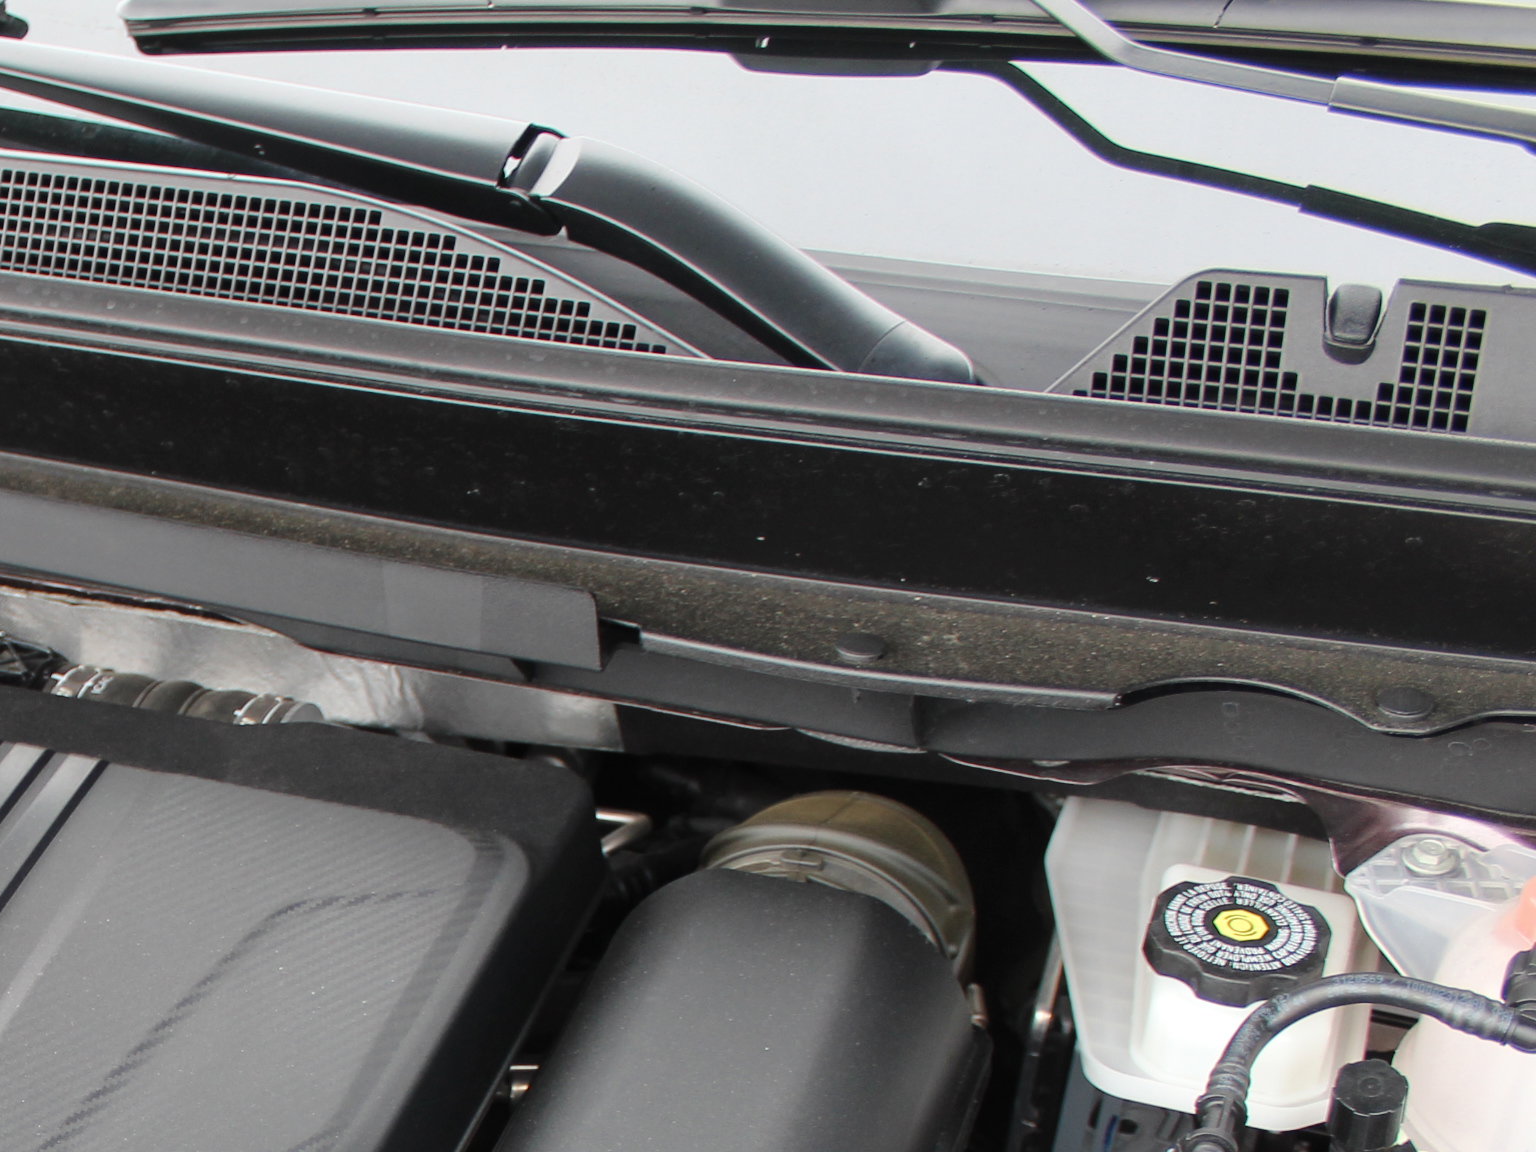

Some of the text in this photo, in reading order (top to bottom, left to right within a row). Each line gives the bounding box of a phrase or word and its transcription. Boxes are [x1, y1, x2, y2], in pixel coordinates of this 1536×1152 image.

[1235, 885, 1285, 903] CONTAINER.
[1280, 901, 1309, 921] SEALED
[1183, 944, 1227, 966] NETTOYER
